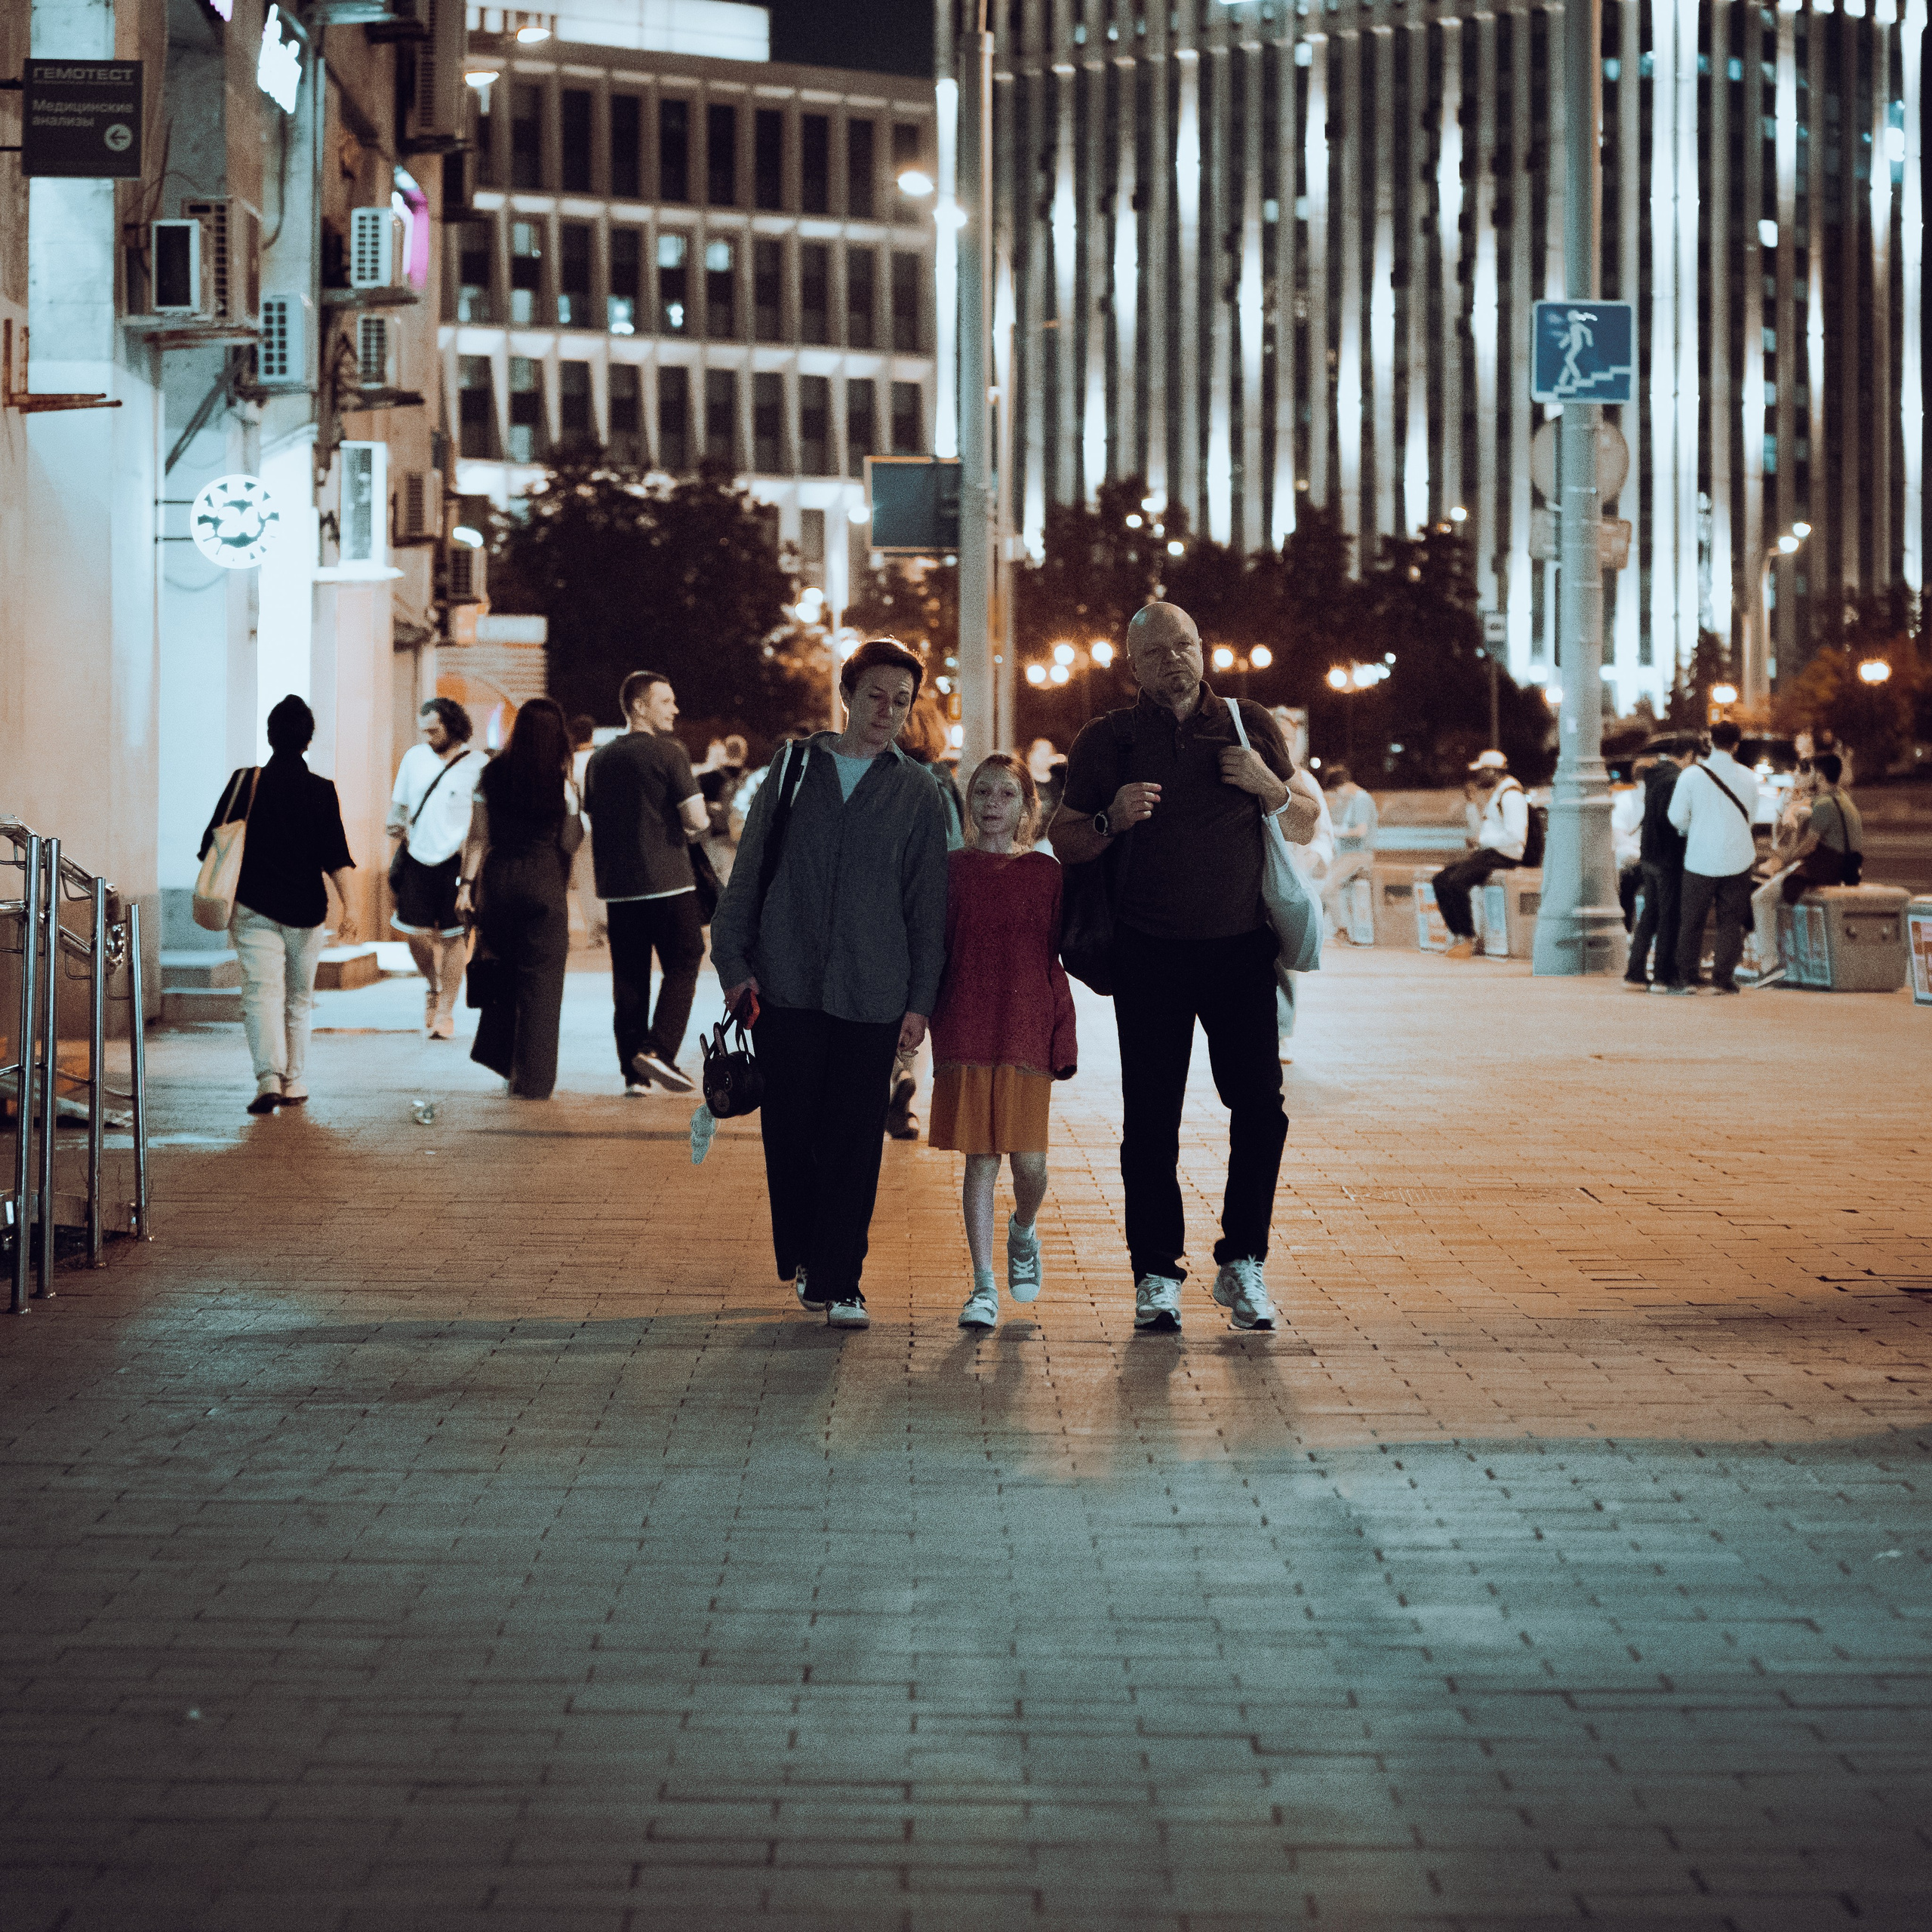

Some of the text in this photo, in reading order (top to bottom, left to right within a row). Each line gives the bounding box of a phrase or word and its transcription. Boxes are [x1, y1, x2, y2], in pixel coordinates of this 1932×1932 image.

[32, 67, 134, 80] ГЕМОТЕСТ
[32, 99, 134, 113] Медицинские
[32, 115, 95, 128] анализы
